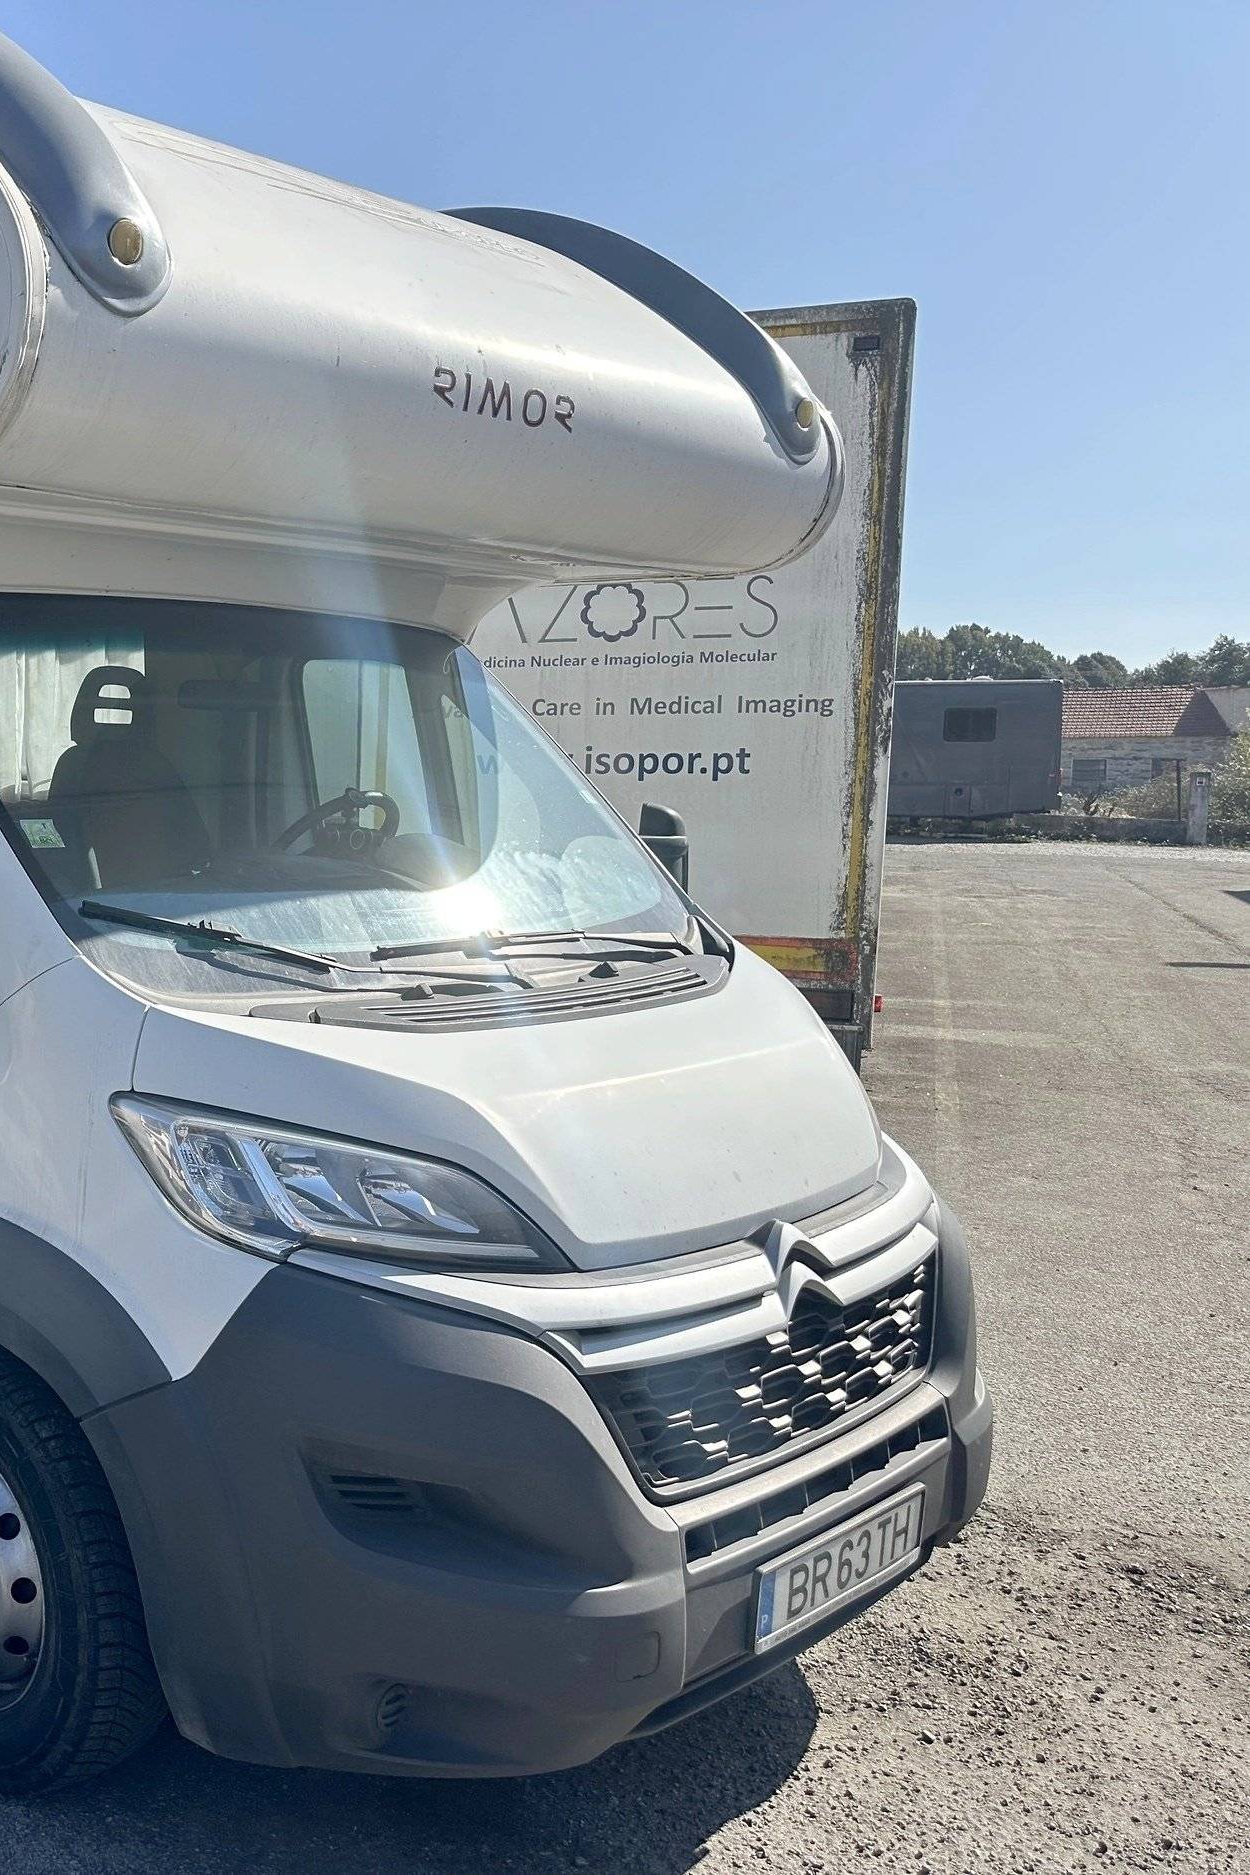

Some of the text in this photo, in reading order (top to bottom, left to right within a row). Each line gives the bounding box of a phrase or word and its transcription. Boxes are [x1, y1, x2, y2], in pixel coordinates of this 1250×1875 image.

[433, 365, 576, 433] RIMOR
[483, 650, 778, 668] dicina Nuclear e Imagiologia Molecular
[531, 693, 835, 718] Care in Medical Imaging
[760, 1615, 768, 1629] P
